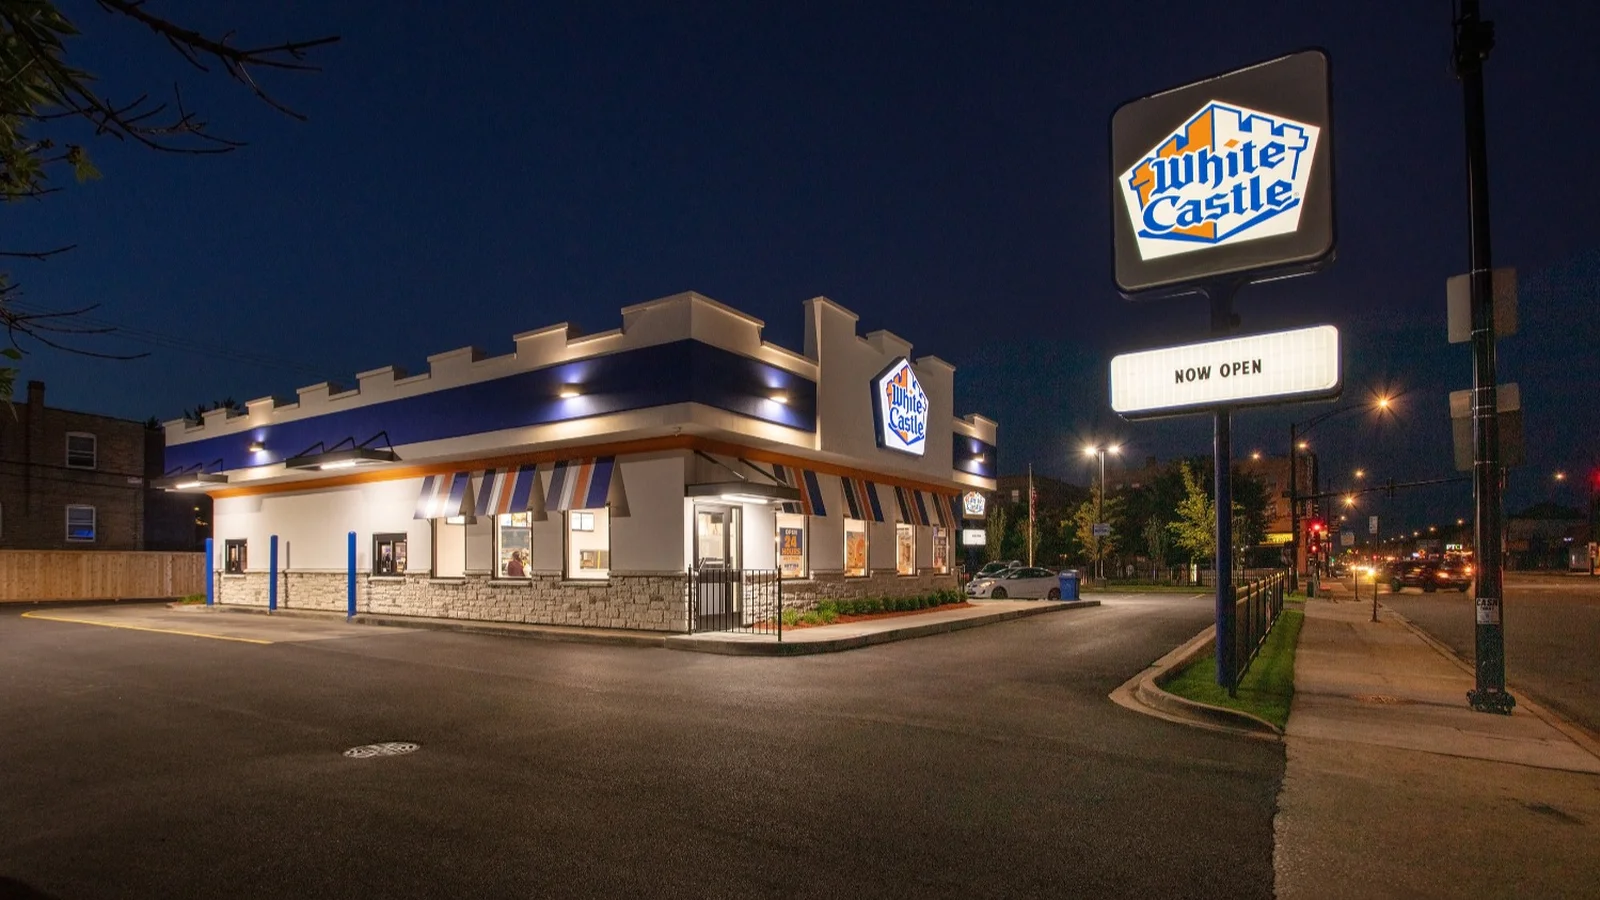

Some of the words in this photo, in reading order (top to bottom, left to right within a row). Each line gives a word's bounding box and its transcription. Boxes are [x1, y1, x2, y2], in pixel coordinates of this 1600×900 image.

[1150, 139, 1286, 195] White
[1143, 176, 1293, 232] Castle
[1175, 366, 1211, 384] NOW
[1220, 359, 1261, 378] OPEN
[892, 384, 923, 414] White
[890, 407, 924, 435] Castle
[781, 547, 801, 555] HOURS
[784, 535, 797, 548] 24
